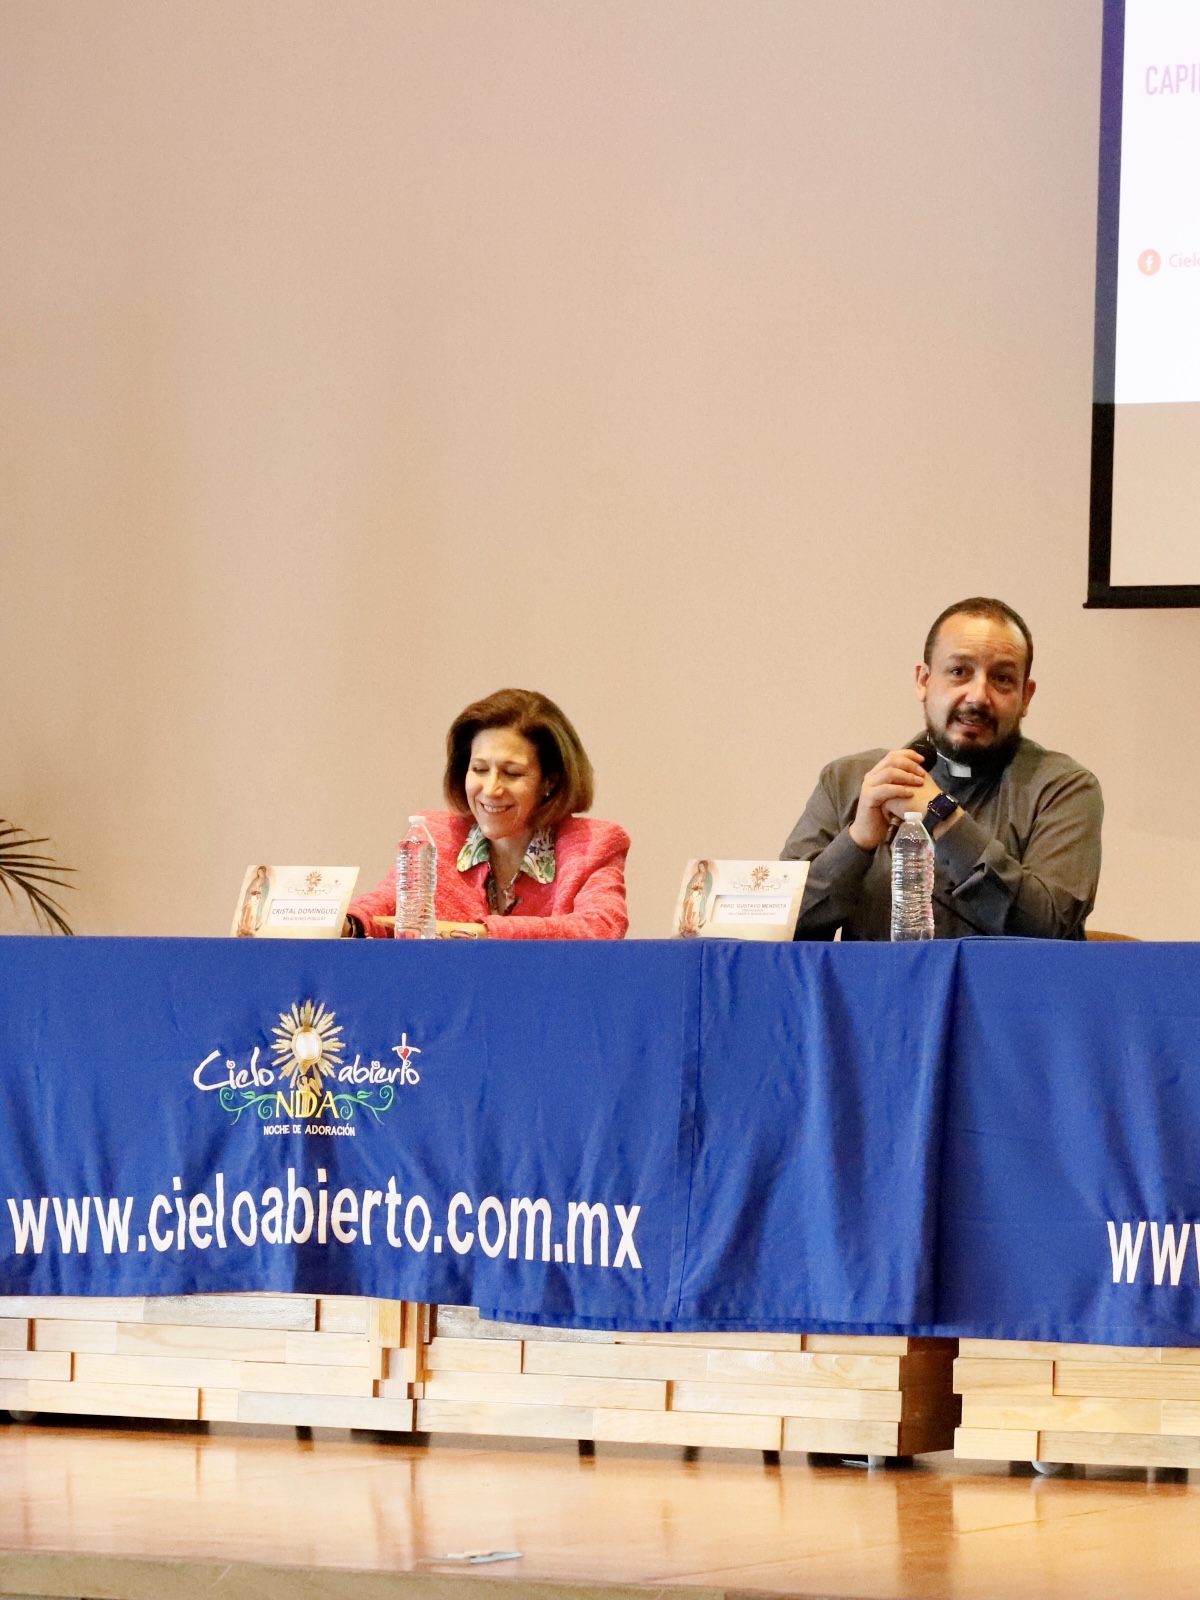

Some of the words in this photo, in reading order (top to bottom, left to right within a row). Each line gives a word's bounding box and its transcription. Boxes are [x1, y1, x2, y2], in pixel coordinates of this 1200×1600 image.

[193, 1047, 275, 1091] Cielo
[338, 1033, 421, 1086] abierto
[275, 1090, 340, 1119] NDA
[263, 1124, 290, 1136] NOCHE
[293, 1125, 301, 1135] DE
[305, 1123, 356, 1137] ADORACIÓN
[8, 1168, 642, 1268] www.cieloabierto.com.mx
